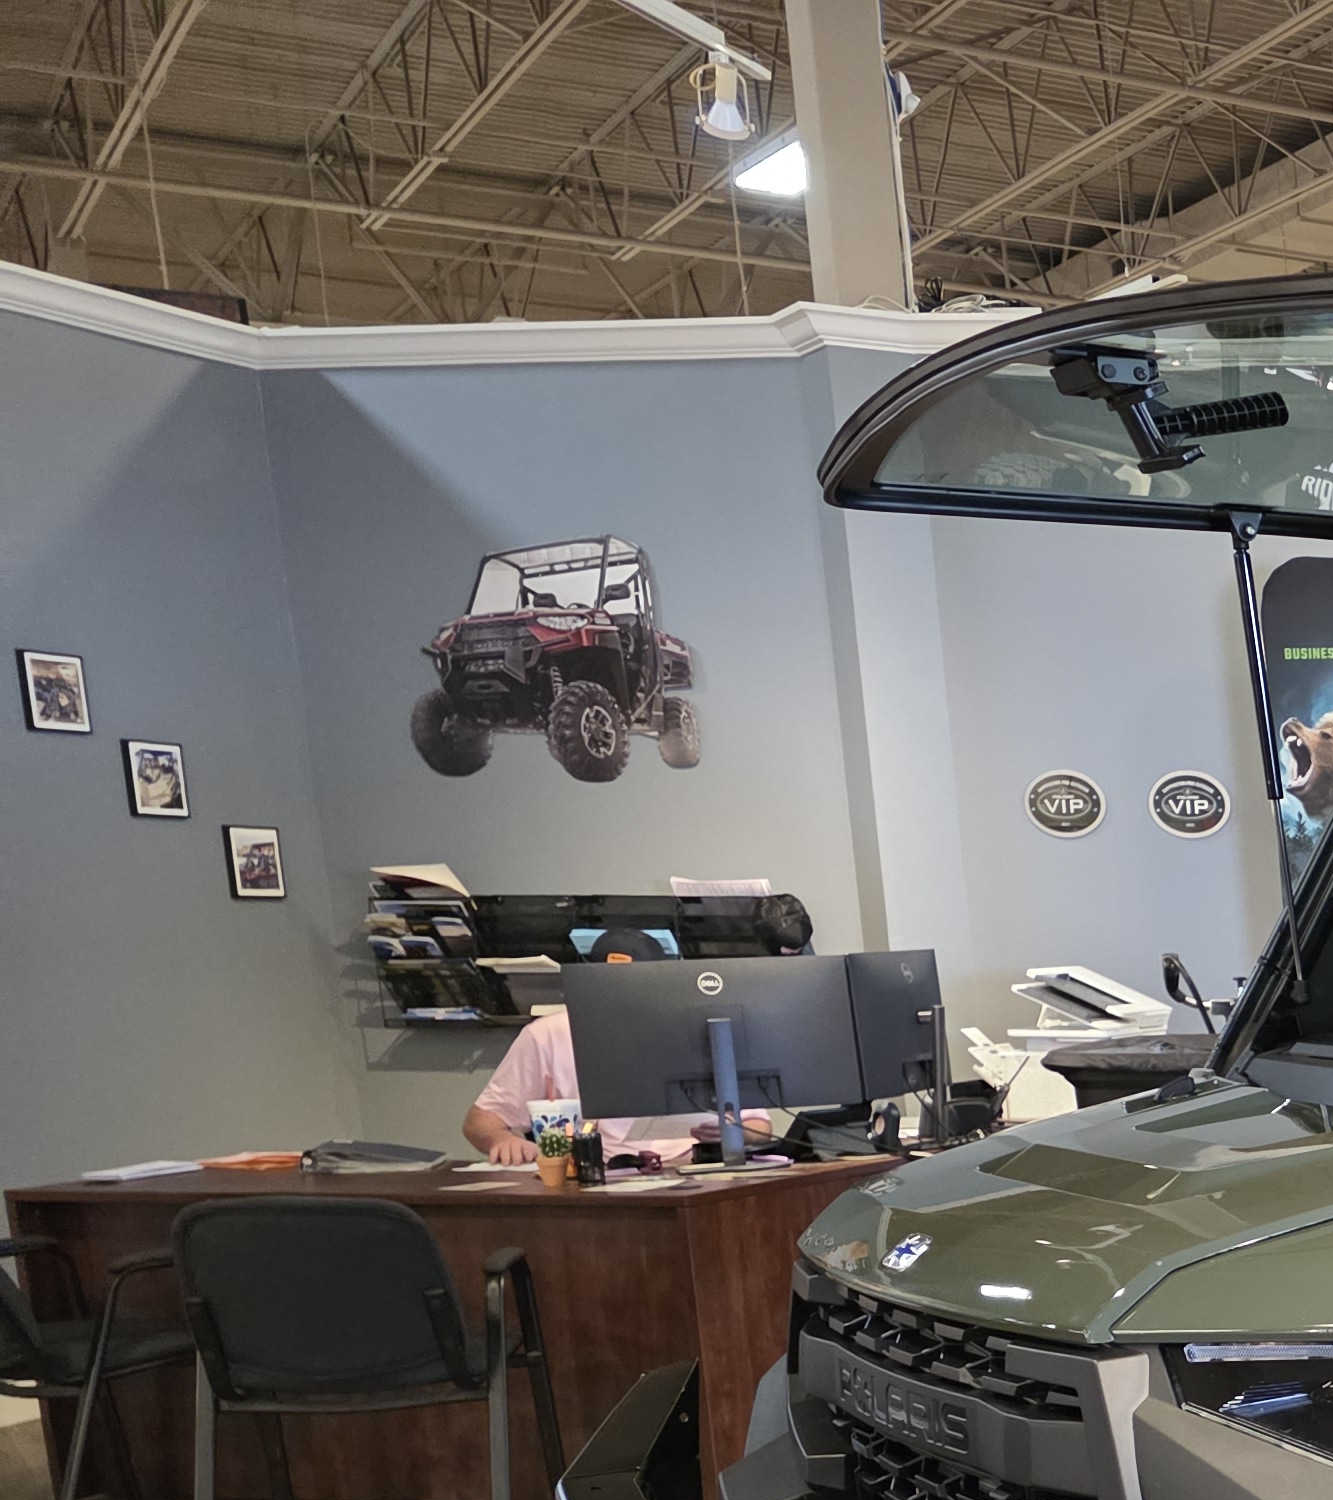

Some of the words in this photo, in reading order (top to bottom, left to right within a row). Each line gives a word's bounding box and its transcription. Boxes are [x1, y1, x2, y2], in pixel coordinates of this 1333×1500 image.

[1044, 798, 1084, 814] VIP
[1168, 798, 1209, 815] VIP
[839, 1357, 969, 1455] POLARIS
